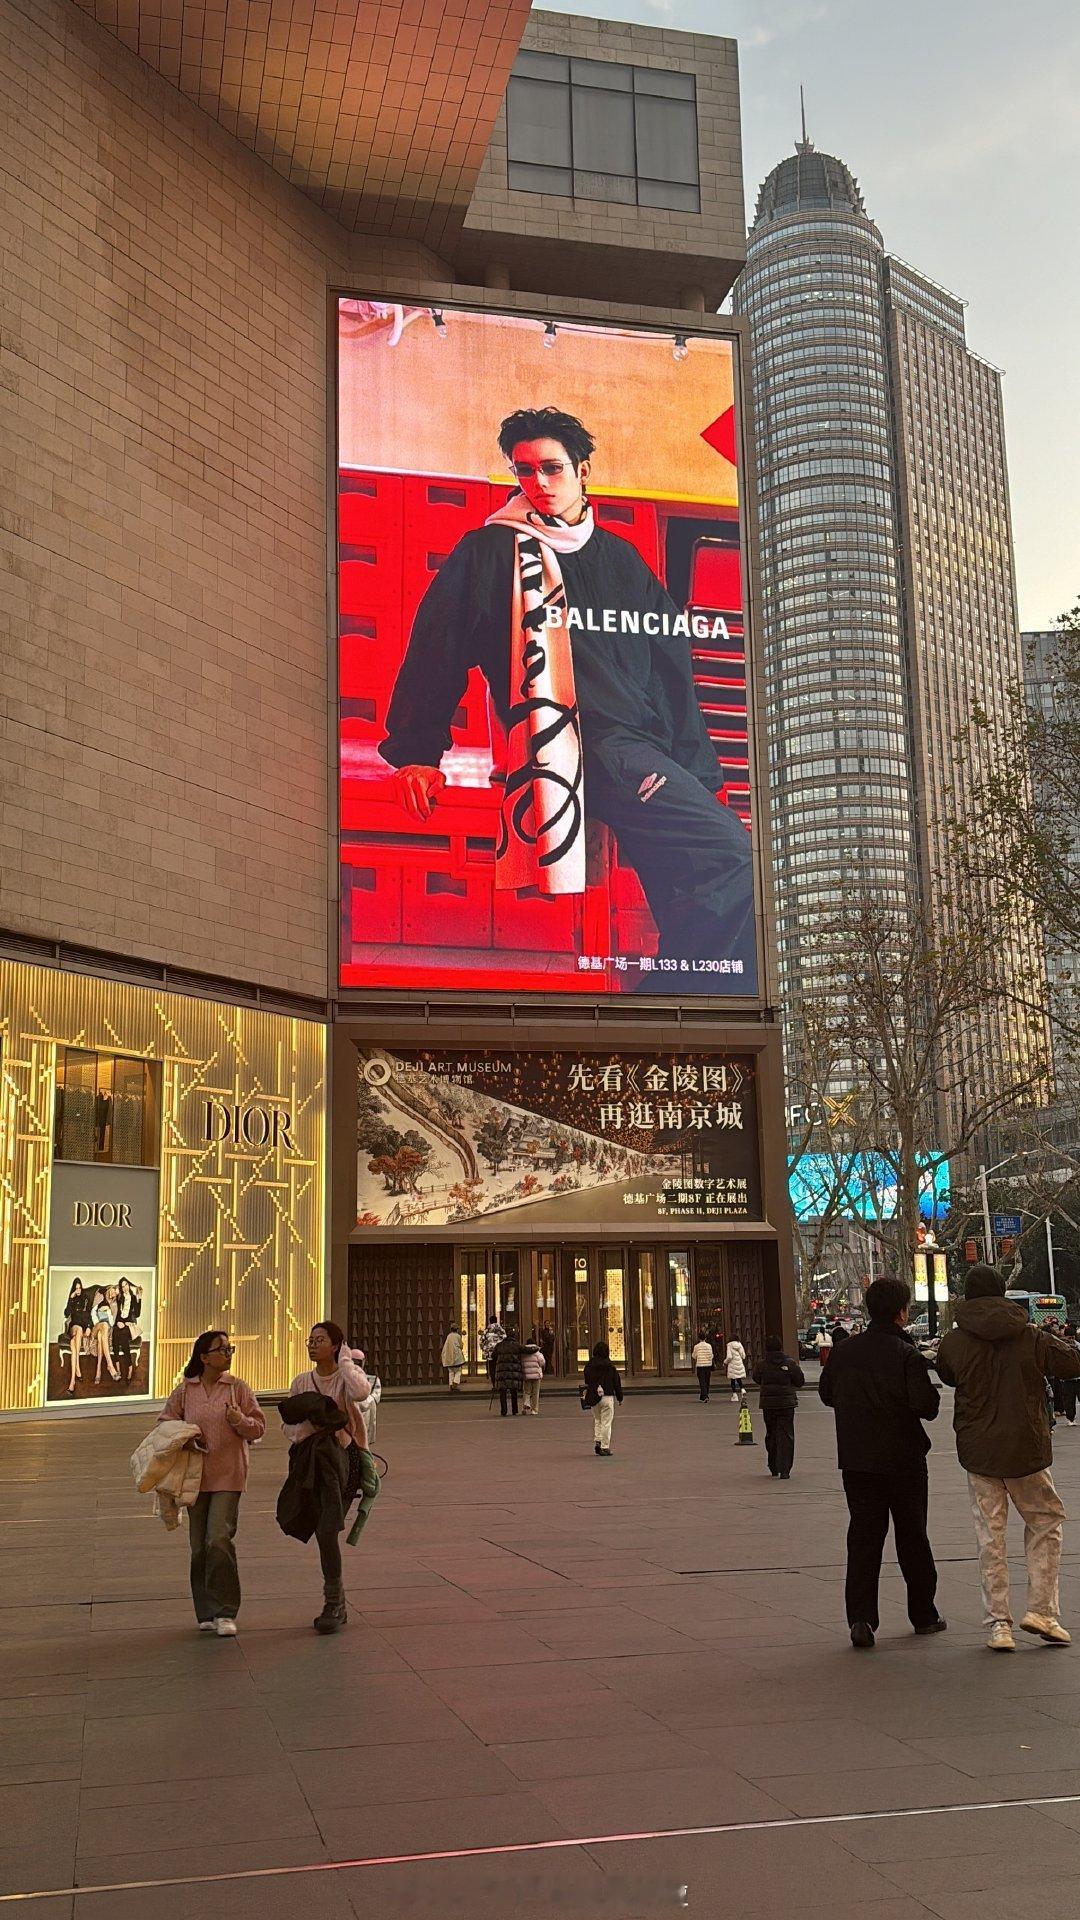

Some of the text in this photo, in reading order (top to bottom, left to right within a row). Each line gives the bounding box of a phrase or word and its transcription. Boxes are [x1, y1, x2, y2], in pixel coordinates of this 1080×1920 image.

[545, 605, 730, 640] BALENCIAGA
[577, 955, 744, 974] 德基广场一期L133 & L230店铺
[395, 1061, 512, 1073] DEJI ART MUSEUM
[395, 1074, 474, 1085] 德基艺术博物馆
[567, 1063, 743, 1093] 先看《金陵图》
[201, 1100, 294, 1150] DIOR
[598, 1102, 743, 1130] 再逛南京城
[661, 1178, 748, 1190] 金陵图数字艺术展
[705, 1192, 748, 1204] 正在展出
[72, 1200, 133, 1229] DIOR
[670, 1207, 695, 1215] PHASE
[706, 1207, 722, 1215] DEJI
[724, 1207, 748, 1215] PLAZA
